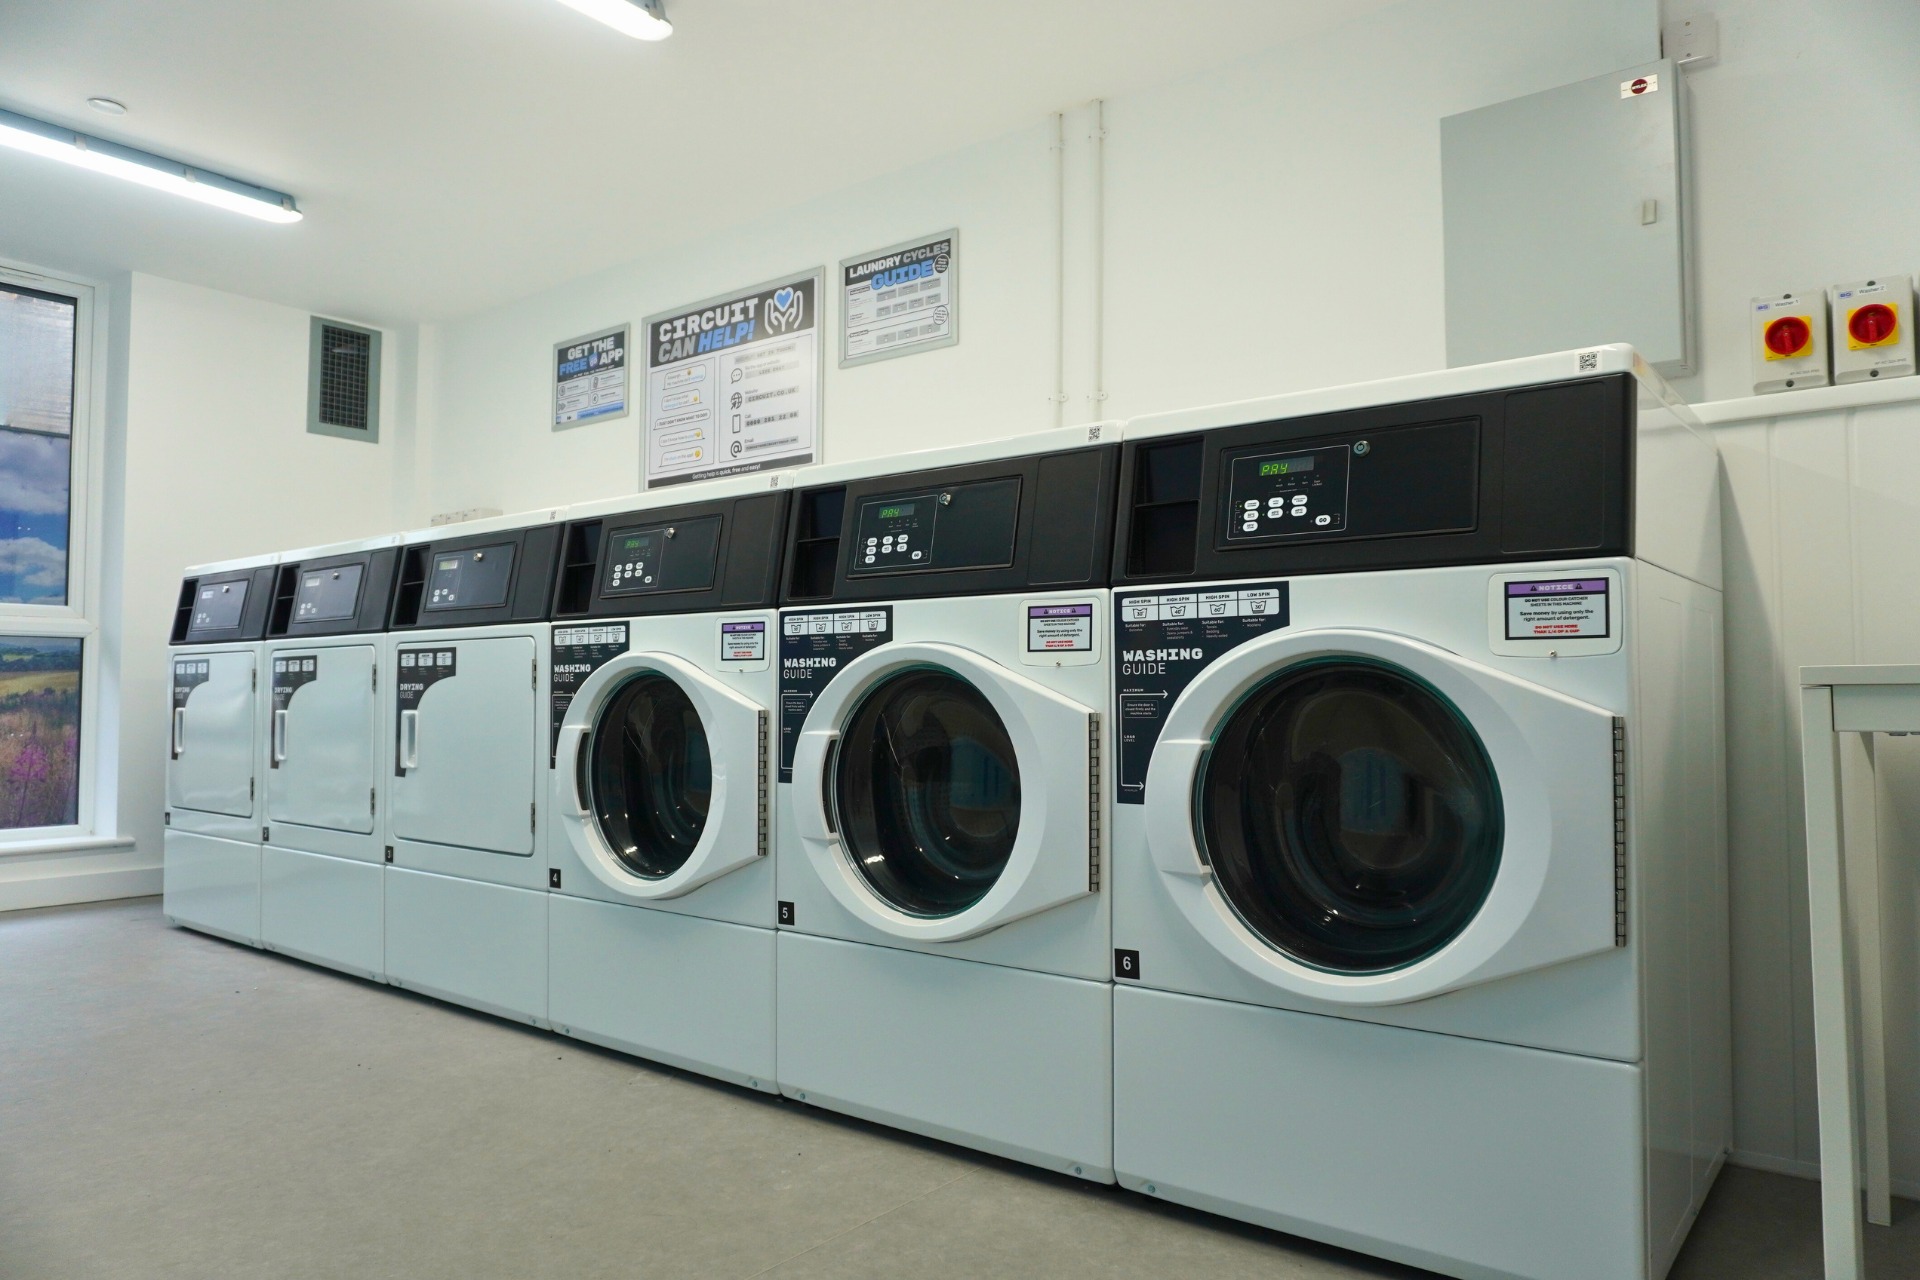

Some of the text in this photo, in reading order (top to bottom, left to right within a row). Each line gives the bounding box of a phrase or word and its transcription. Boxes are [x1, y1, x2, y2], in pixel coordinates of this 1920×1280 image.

[850, 242, 949, 278] LAUNDRY CYCLES
[870, 259, 934, 290] GUIDE
[660, 298, 758, 342] CIRCUIT
[568, 336, 614, 360] GET THE
[658, 320, 755, 362] CAN HELP!
[560, 358, 587, 376] FREE
[599, 348, 623, 365] APP
[748, 387, 796, 402] CIRCUIT.CO.UK
[1262, 464, 1288, 476] PAY
[1123, 648, 1203, 662] WASHING
[554, 664, 591, 673] WASHING
[784, 658, 836, 668] WASHING
[1122, 662, 1166, 675] GUIDE
[554, 674, 574, 682] GUIDE
[784, 669, 812, 679] GUIDE
[552, 873, 557, 882] 4
[782, 907, 788, 918] 5
[1123, 956, 1131, 970] 6
